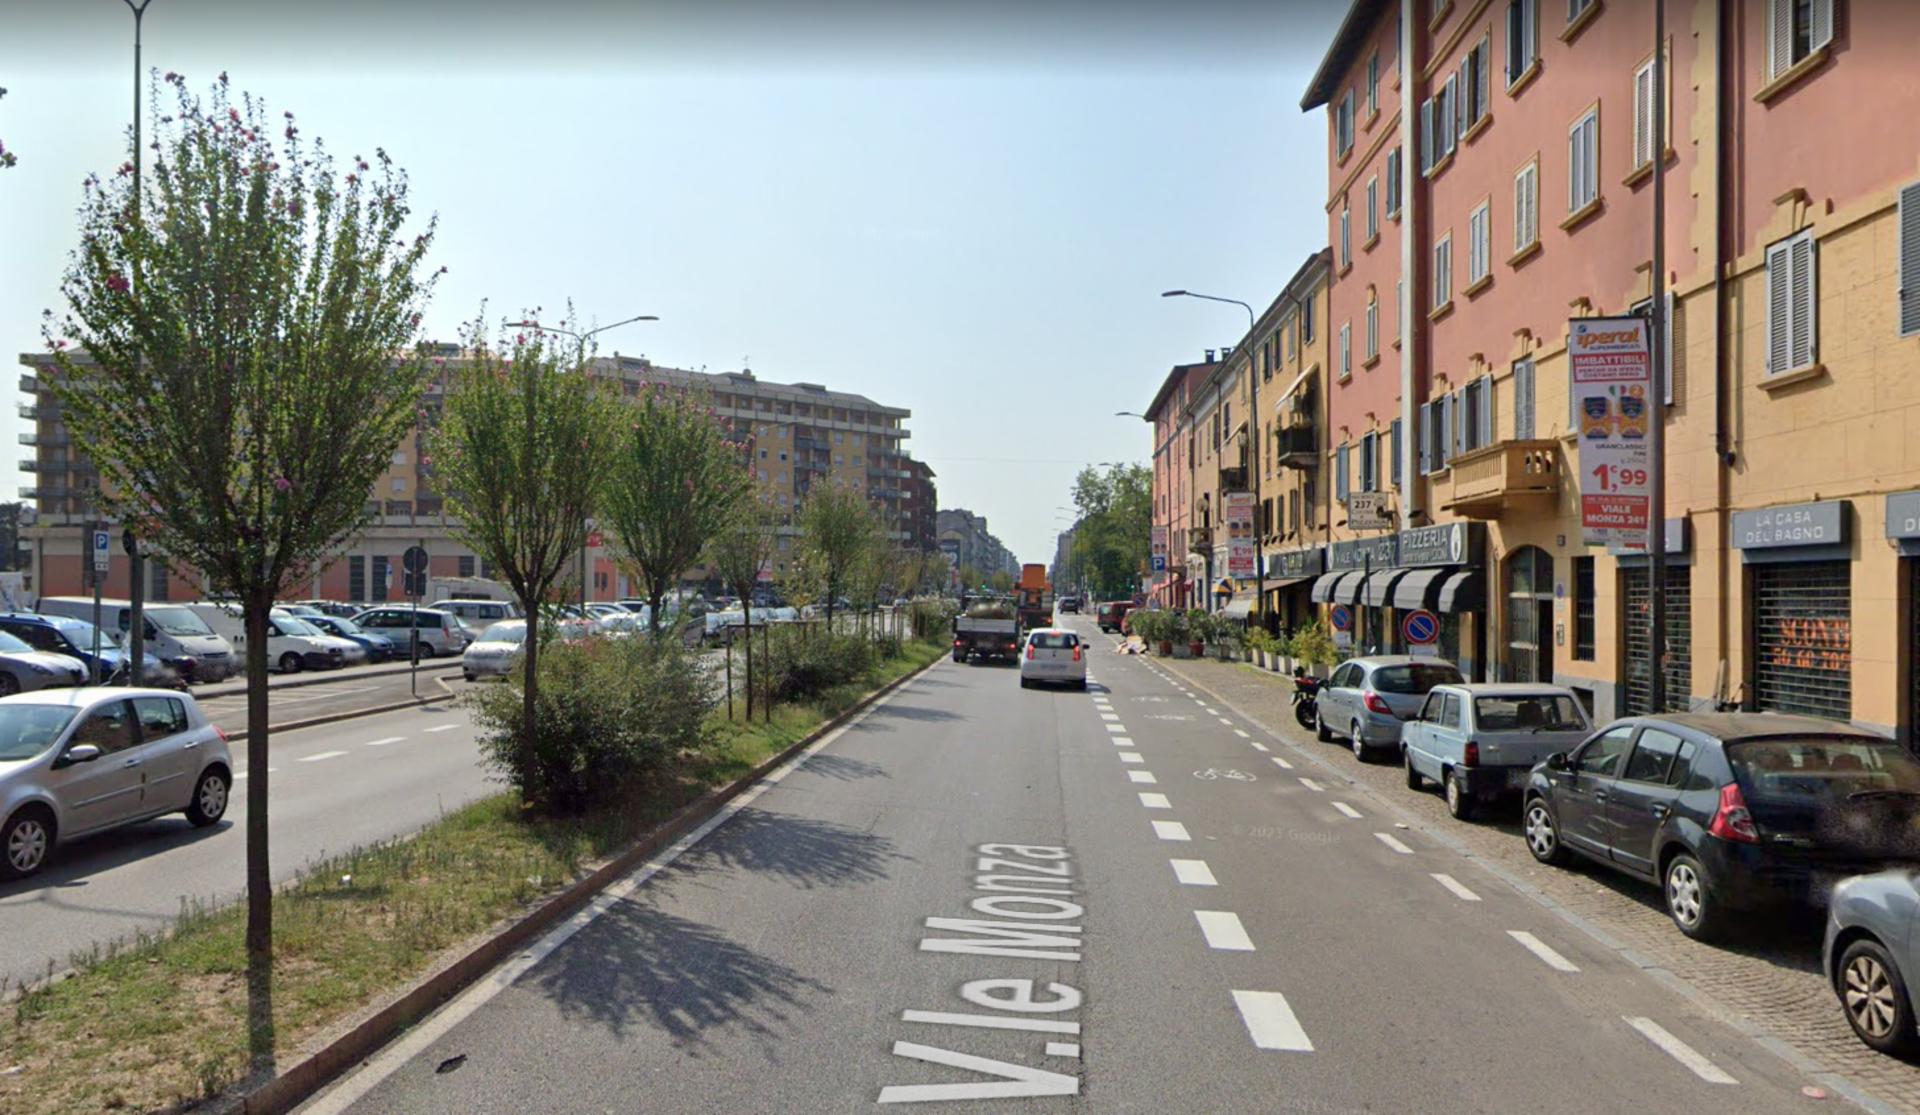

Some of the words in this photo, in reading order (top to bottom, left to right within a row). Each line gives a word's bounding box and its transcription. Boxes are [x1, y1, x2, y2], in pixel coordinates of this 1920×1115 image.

[1576, 325, 1640, 349] iperal
[1575, 355, 1647, 365] IMBATTIBILI
[1354, 500, 1372, 509] 237
[1600, 504, 1631, 514] VIALE
[1586, 513, 1625, 524] MONZA
[1756, 514, 1771, 527] LA
[1775, 511, 1812, 526] CASA
[1402, 528, 1449, 549] PIZZERIA
[1746, 531, 1771, 543] DEL
[1775, 526, 1824, 541] BAGNO
[919, 843, 1084, 962] Monza
